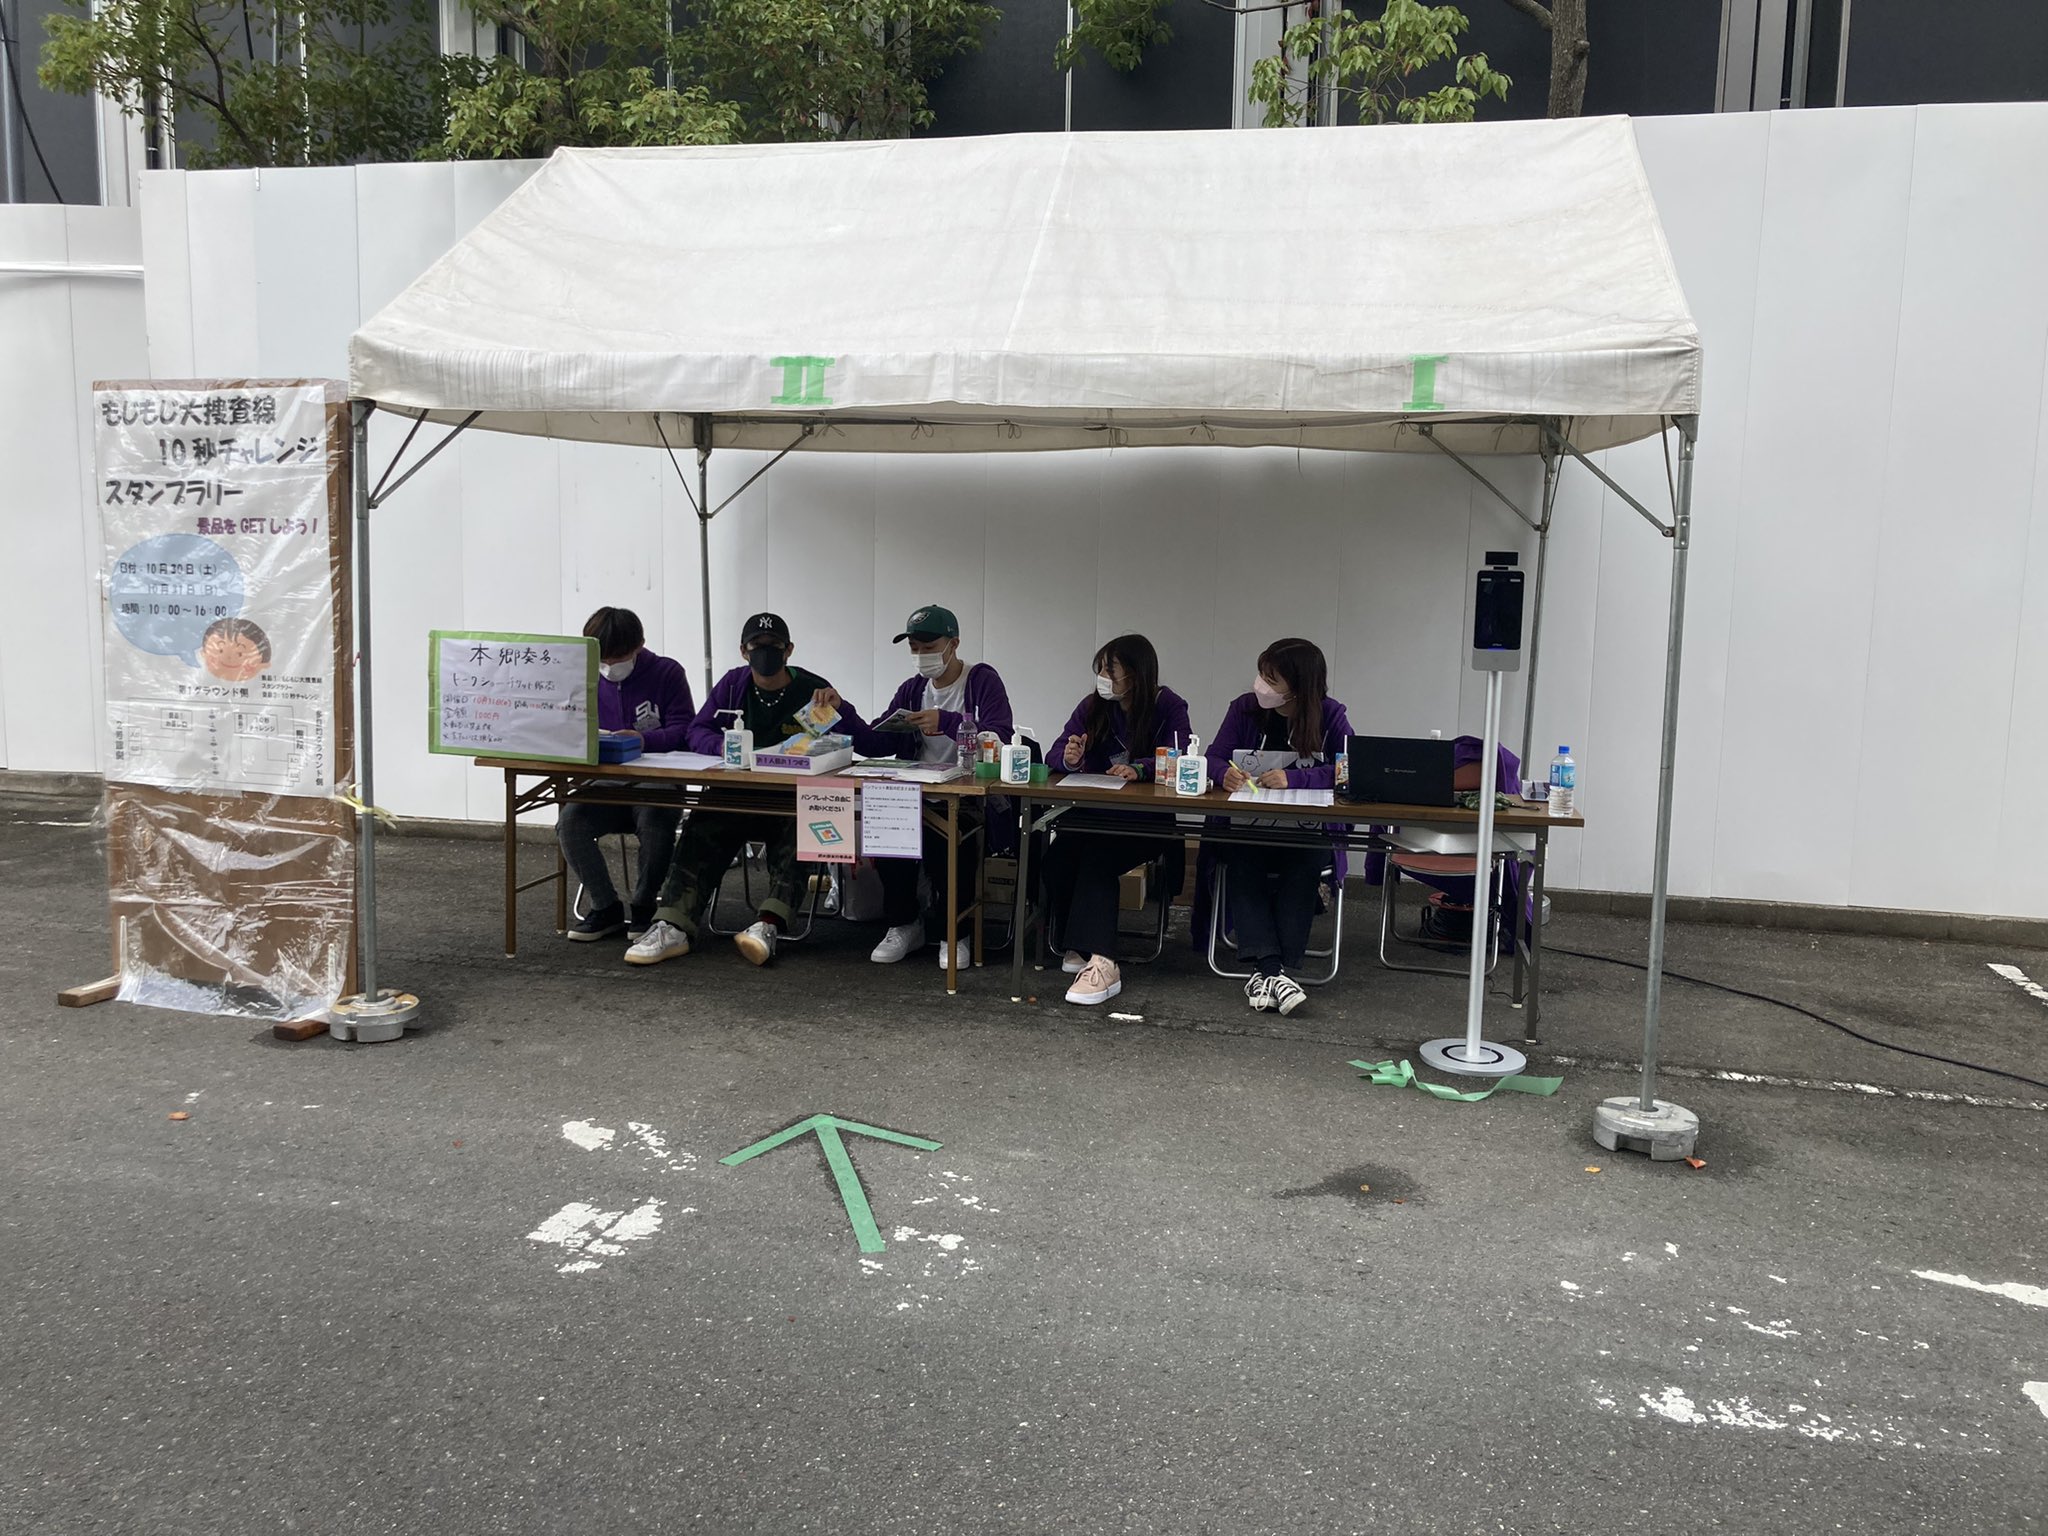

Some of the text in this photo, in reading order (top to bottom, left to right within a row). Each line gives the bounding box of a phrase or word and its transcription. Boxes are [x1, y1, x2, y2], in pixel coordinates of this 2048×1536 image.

[101, 395, 276, 427] もじもじ大捜査線
[159, 436, 318, 467] 10秒チャレンジ
[105, 480, 243, 506] スタンプラリー
